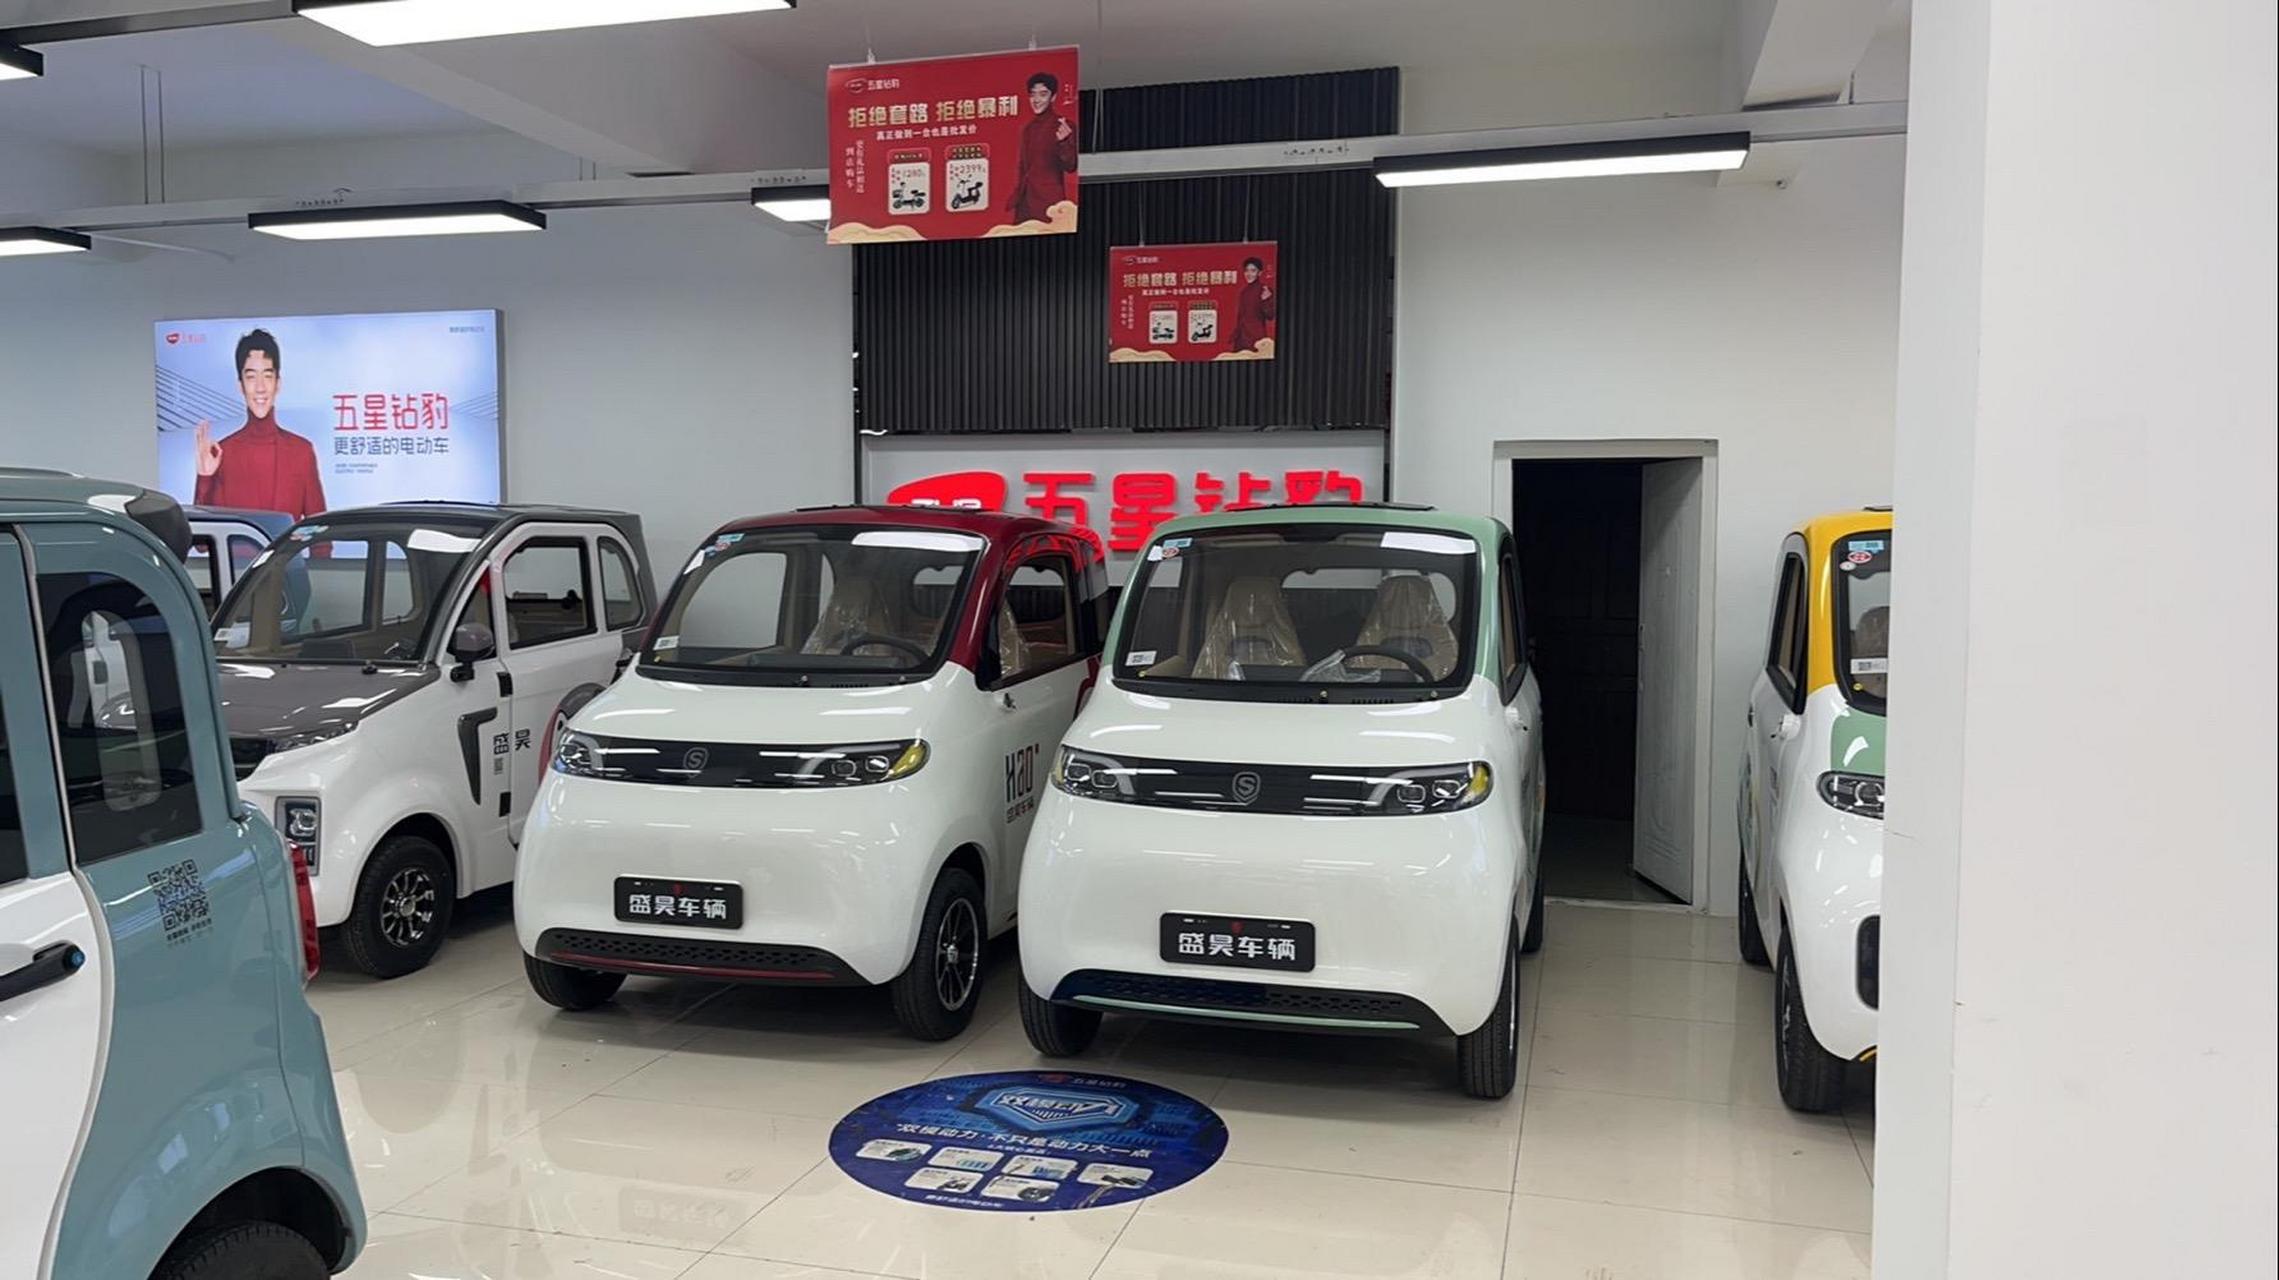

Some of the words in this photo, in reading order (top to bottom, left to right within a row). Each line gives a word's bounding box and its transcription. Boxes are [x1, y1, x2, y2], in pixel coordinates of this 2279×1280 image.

[848, 102, 929, 129] 拒绝套路
[936, 95, 1019, 122] 拒绝暴利
[333, 393, 449, 430] 五星钻豹
[334, 436, 450, 455] 更舒适的电动车
[493, 728, 531, 755] 盛昊
[629, 894, 727, 919] 盛昊车辆
[1178, 932, 1296, 961] 盛昊车辆
